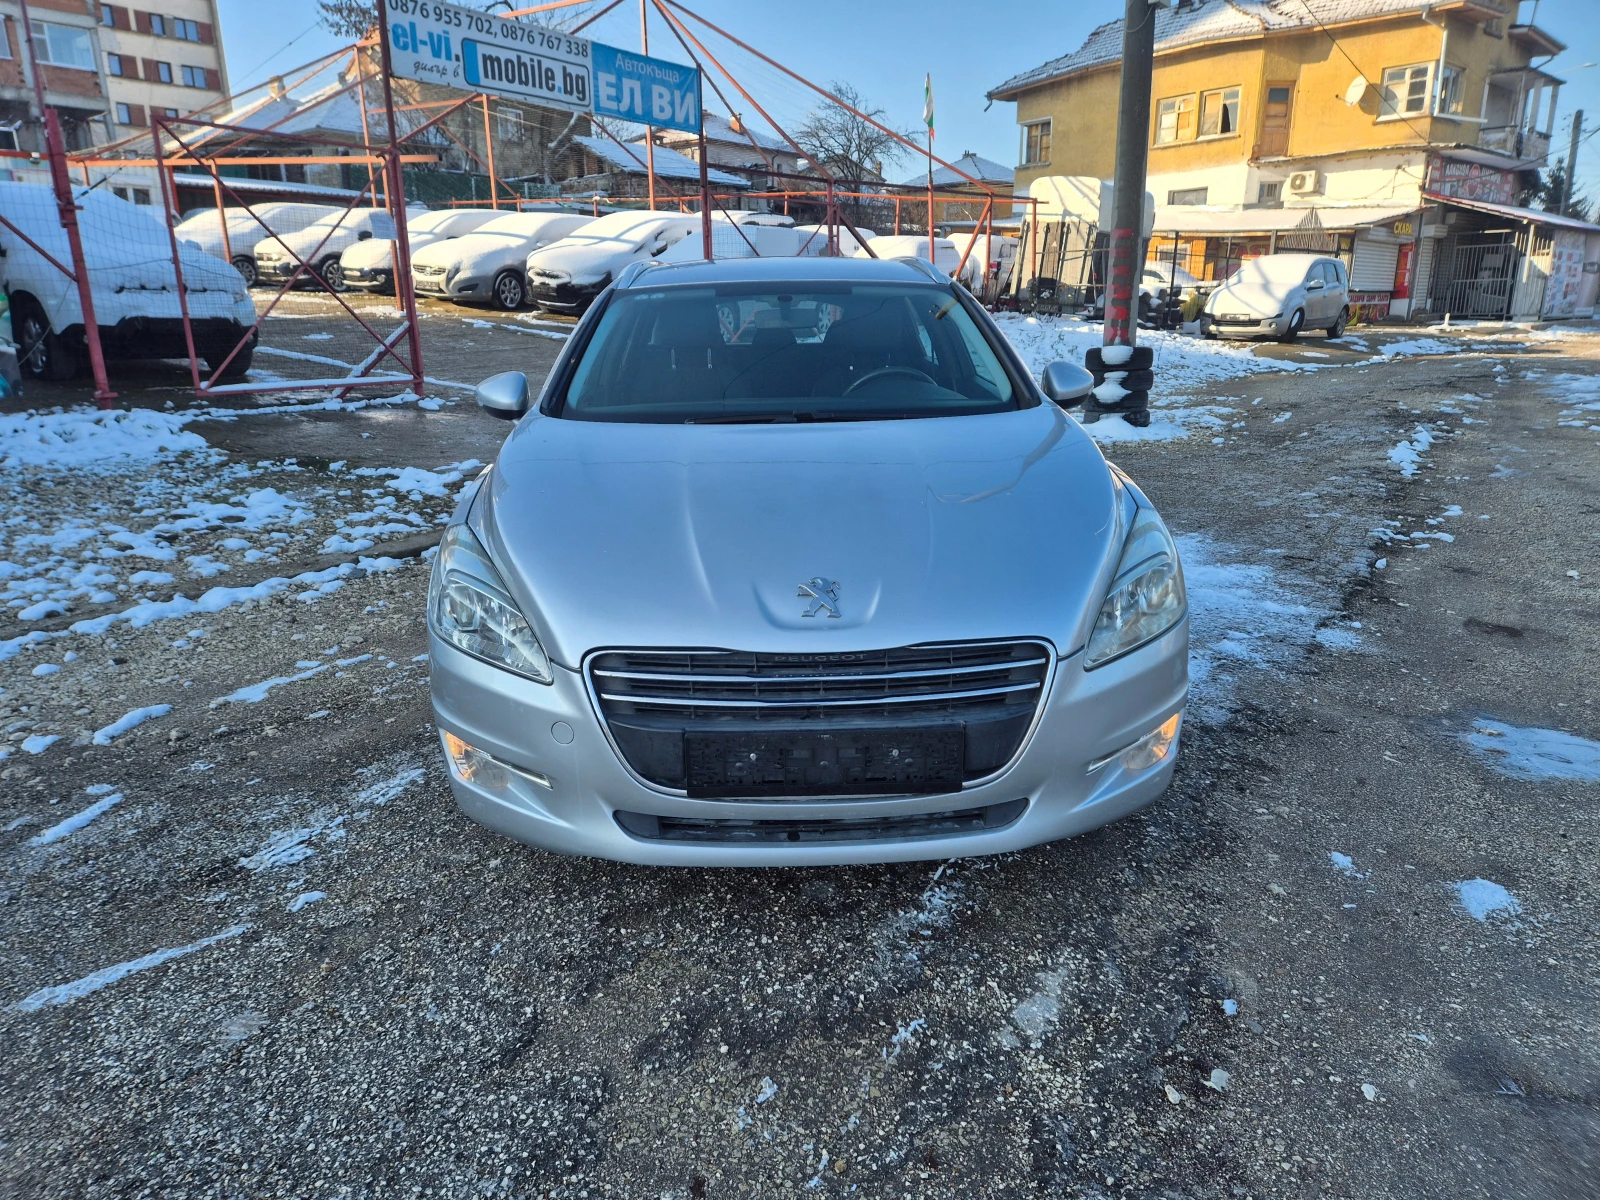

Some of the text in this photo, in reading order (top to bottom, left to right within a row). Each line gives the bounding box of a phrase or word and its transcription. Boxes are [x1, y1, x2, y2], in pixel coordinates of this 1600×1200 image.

[390, 0, 588, 58] 0876 955 702, 0876 767 338
[482, 53, 586, 101] mobile.bg
[615, 53, 680, 84] Автокъща
[598, 71, 695, 125] ЕЛ ВИ
[775, 653, 867, 661] PEUGEOT
